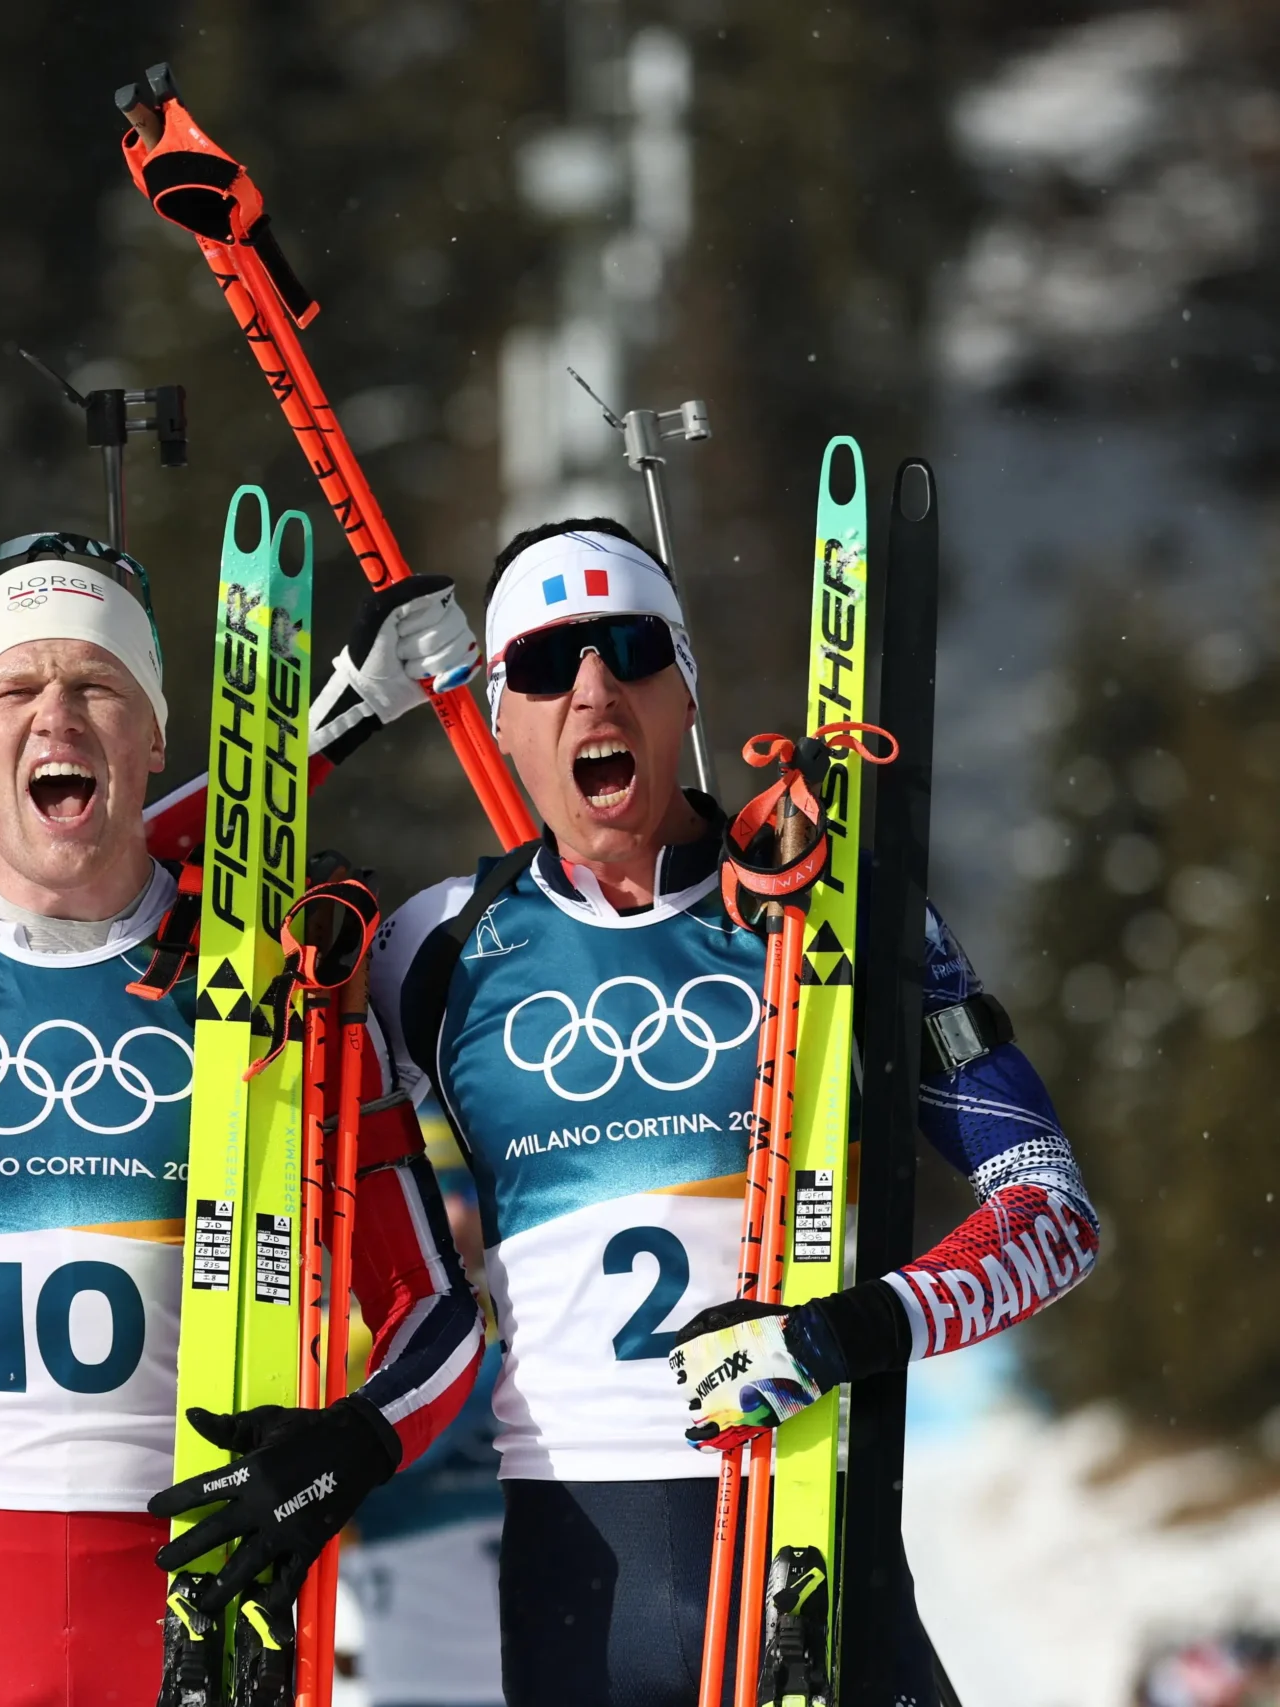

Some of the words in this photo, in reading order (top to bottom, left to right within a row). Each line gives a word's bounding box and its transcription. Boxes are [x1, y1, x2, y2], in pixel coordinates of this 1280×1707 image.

[7, 575, 105, 598] NORGE
[212, 581, 260, 933] FISCHER
[261, 606, 304, 945] FISCHER
[931, 957, 963, 980] FRAN
[505, 1124, 601, 1161] MILANO
[605, 1113, 723, 1142] CORTINA
[728, 1111, 755, 1132] 20
[736, 998, 779, 1300] NE/WAY
[26, 1156, 156, 1179] CORTINA
[163, 1161, 190, 1181] 20
[603, 1226, 690, 1361] 2
[908, 1198, 1095, 1354] FRANCE
[669, 1350, 686, 1371] ETIXX
[696, 1350, 753, 1401] KINETIXX
[203, 1466, 251, 1494] KINETIXX
[273, 1471, 338, 1523] KINETIXX
[715, 1465, 734, 1542] PREMIO
